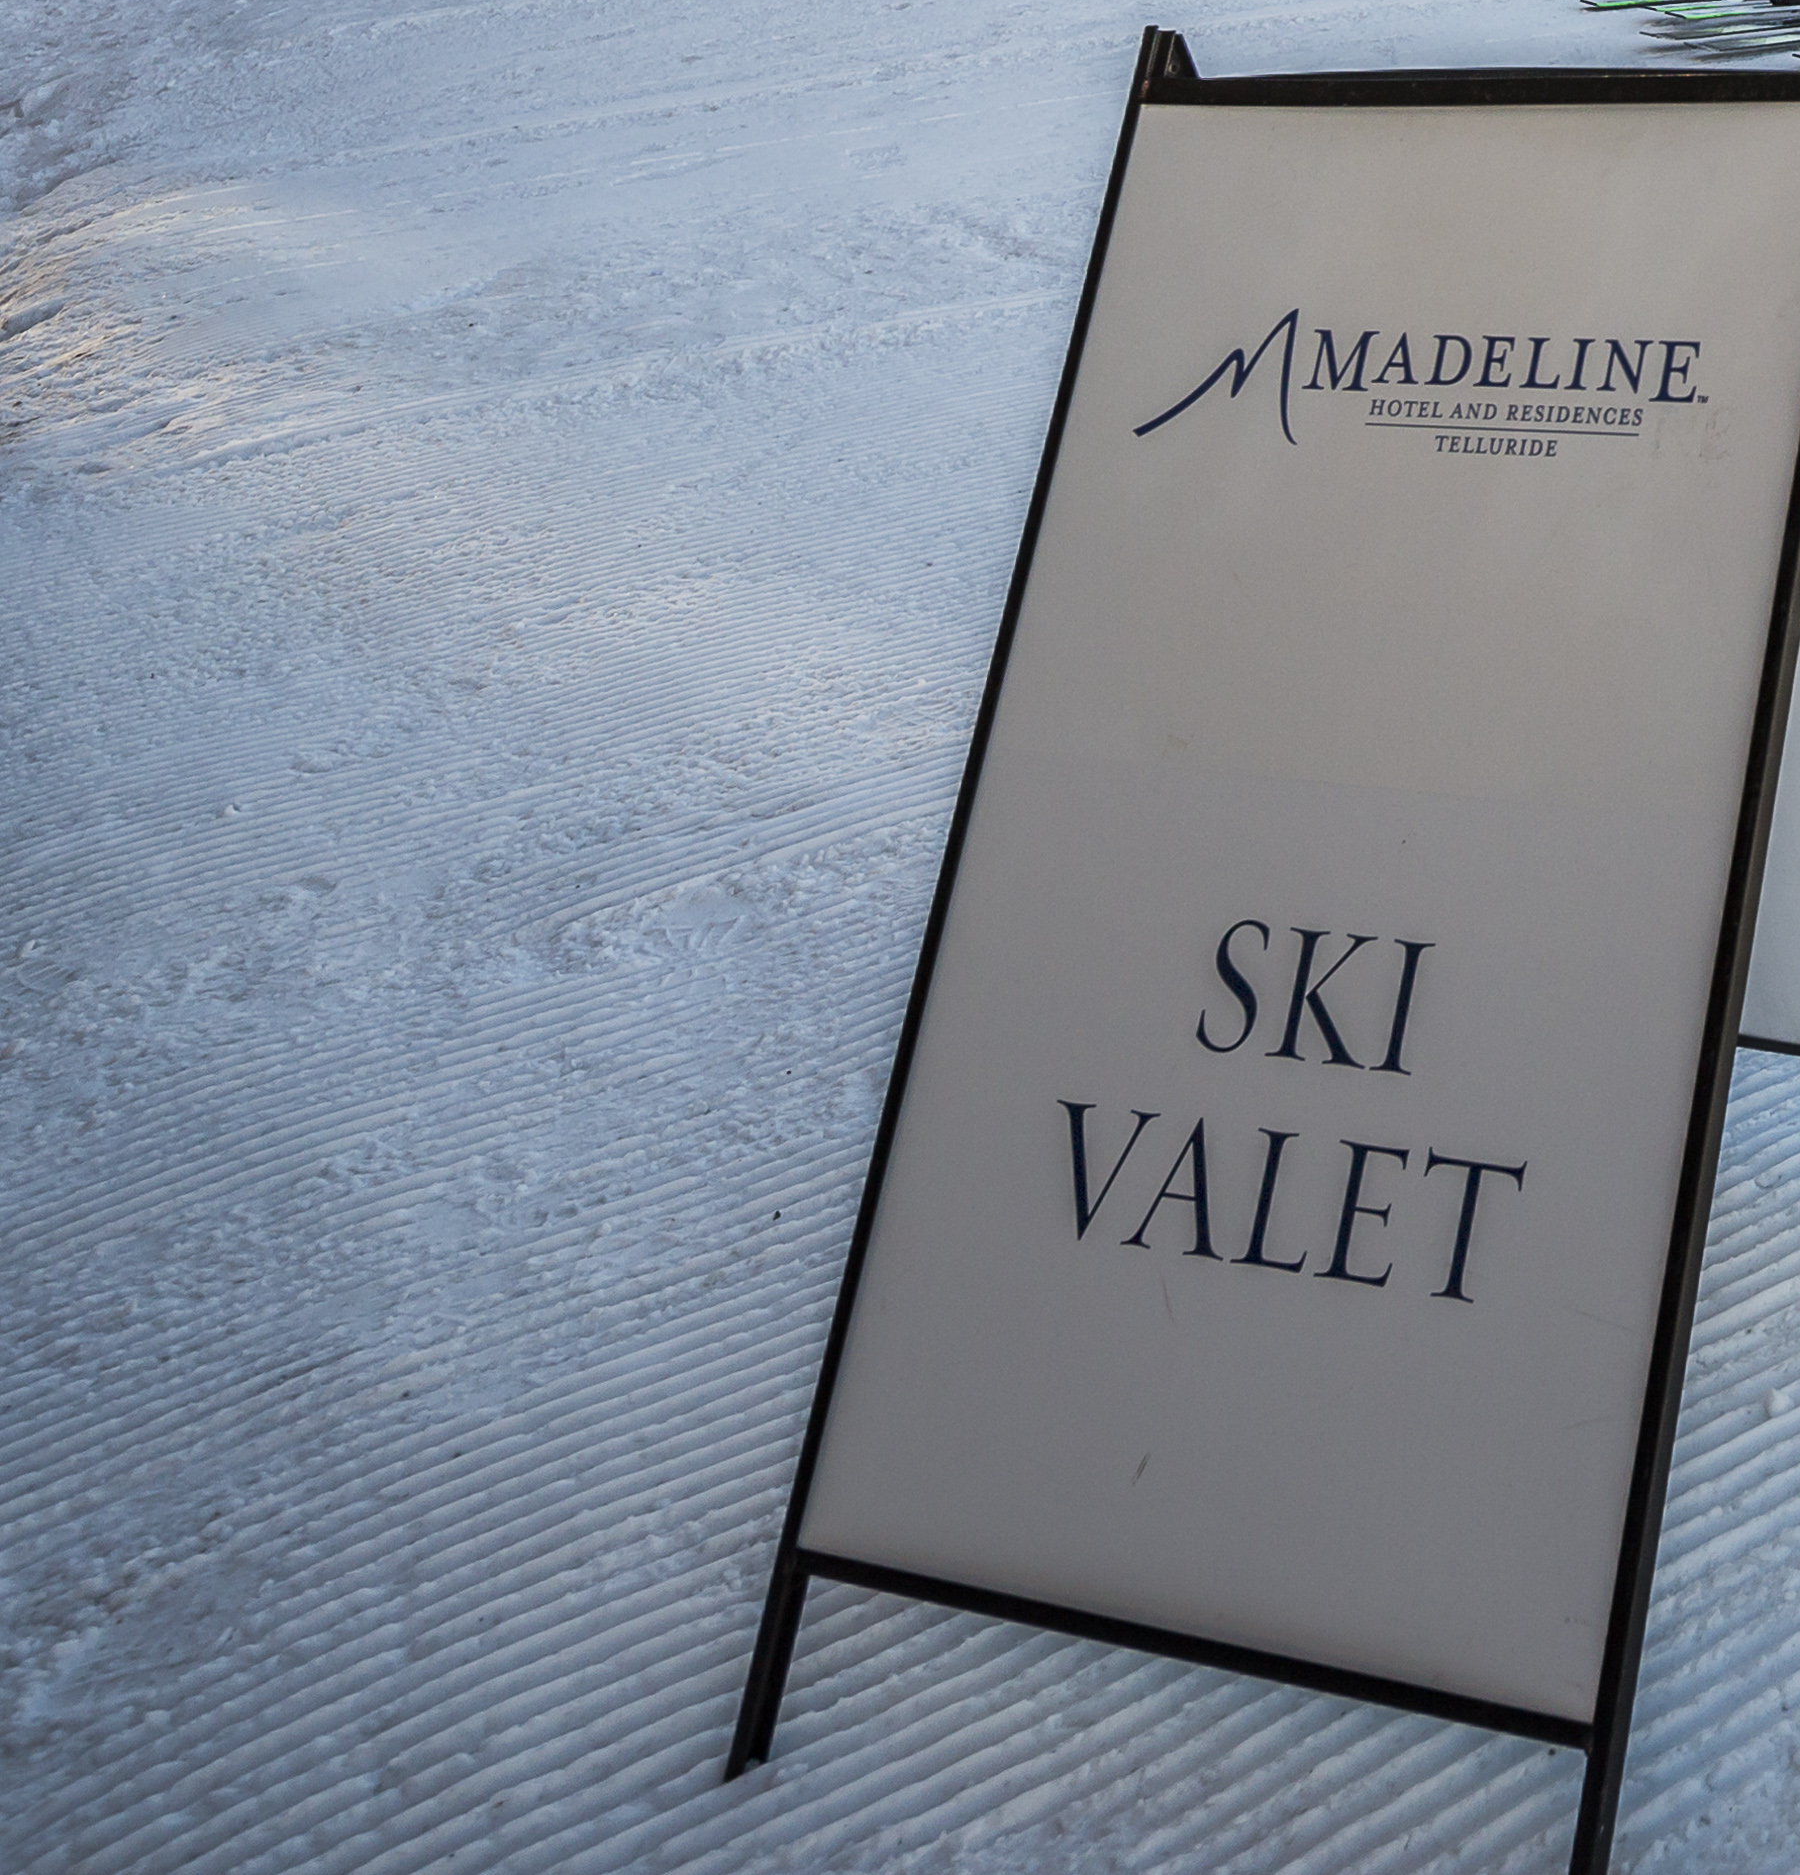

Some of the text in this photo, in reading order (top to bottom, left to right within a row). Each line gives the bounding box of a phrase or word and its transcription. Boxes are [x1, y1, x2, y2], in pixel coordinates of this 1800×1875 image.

[1302, 328, 1701, 404] MADELINE
[1368, 399, 1644, 427] HOTEL AND RESIDENCES
[1434, 434, 1559, 458] TELLURIDE
[1195, 919, 1437, 1076] SKI
[1056, 1099, 1528, 1304] VALET
